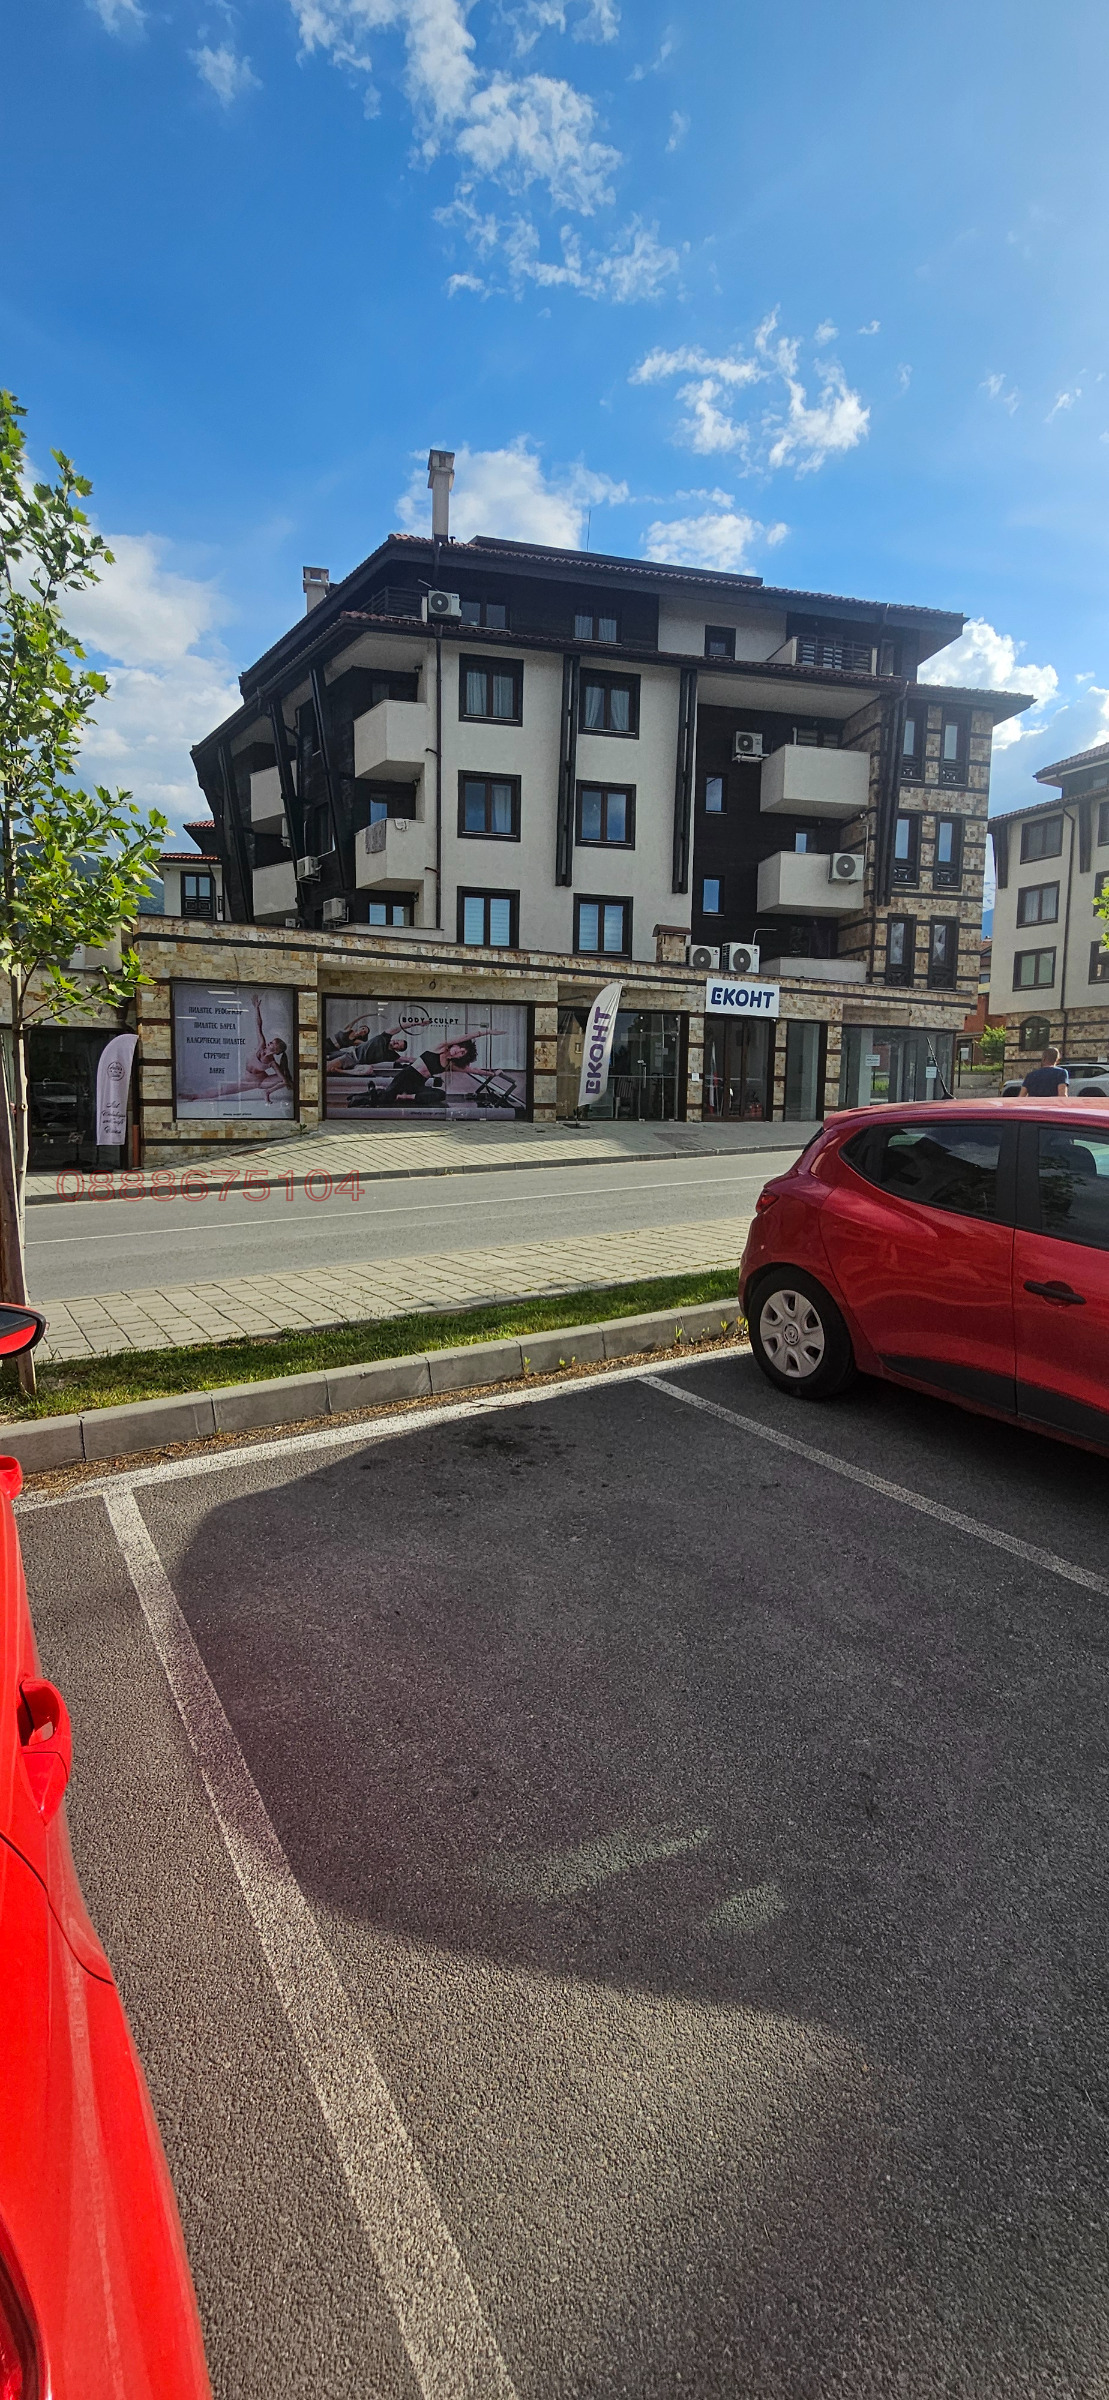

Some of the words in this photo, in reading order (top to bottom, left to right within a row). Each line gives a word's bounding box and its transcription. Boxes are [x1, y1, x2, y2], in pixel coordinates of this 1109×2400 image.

[711, 987, 775, 1009] ЕКОНТ
[428, 1017, 459, 1025] SCULPT
[585, 1006, 611, 1095] ЕКОНТ
